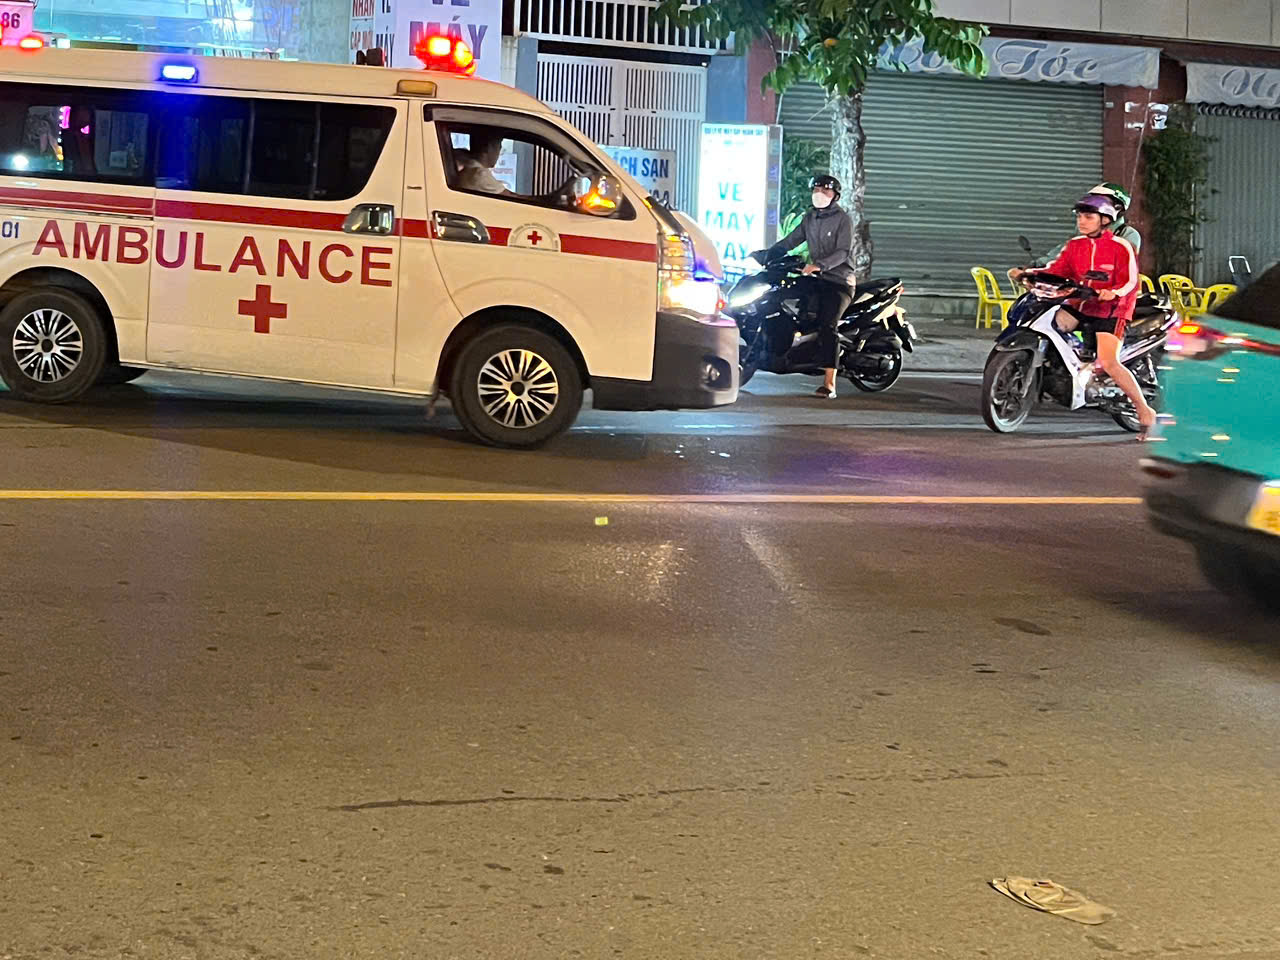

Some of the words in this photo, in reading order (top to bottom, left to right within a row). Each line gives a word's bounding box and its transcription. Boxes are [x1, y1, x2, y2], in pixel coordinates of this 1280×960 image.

[995, 40, 1098, 80] Tóc
[641, 157, 669, 182] SẠN
[32, 219, 394, 288] AMBULANCE
